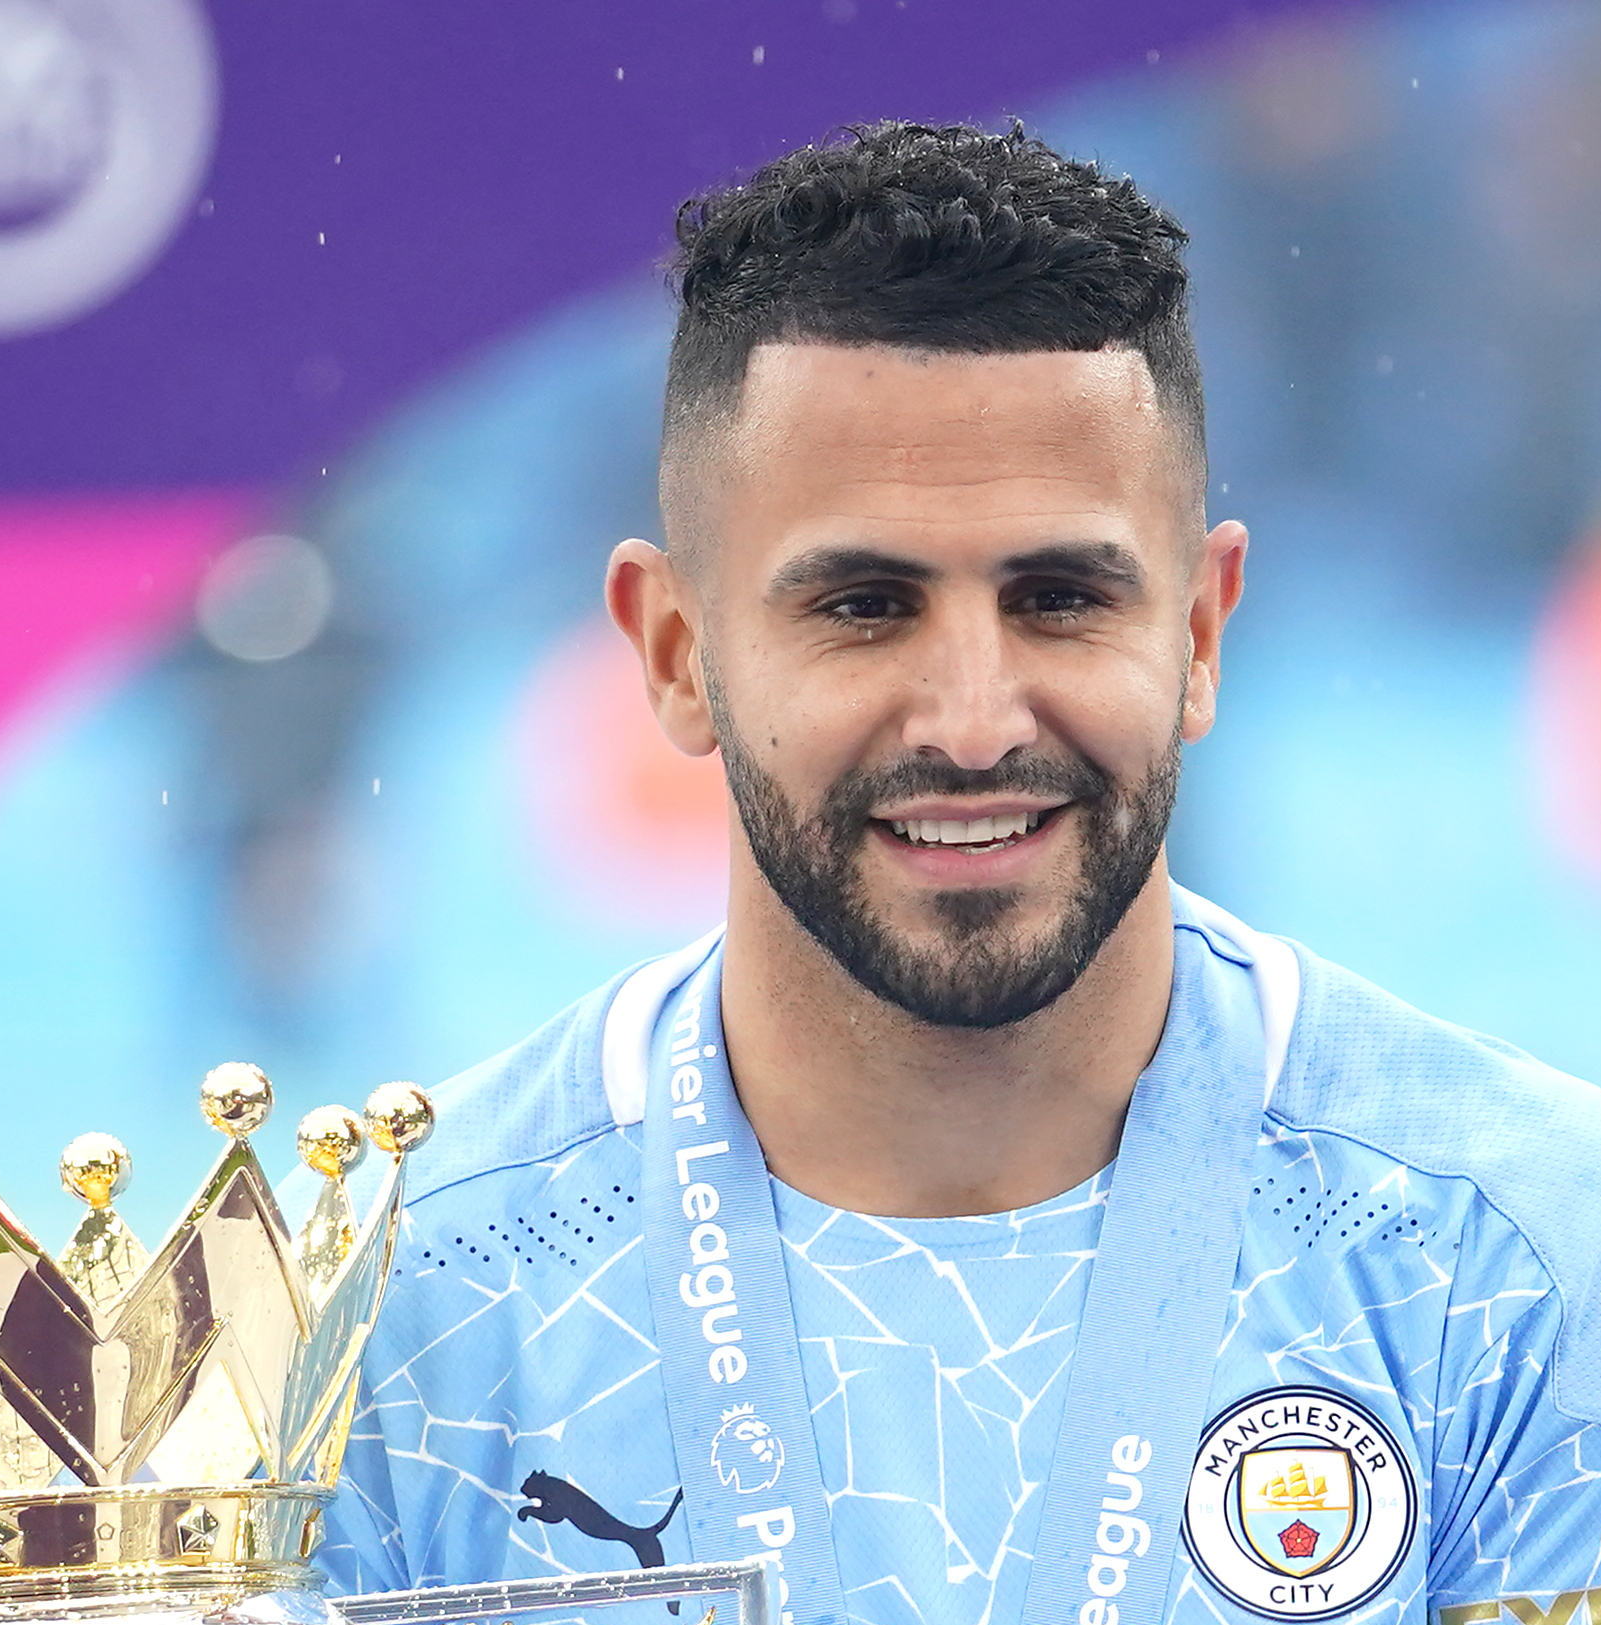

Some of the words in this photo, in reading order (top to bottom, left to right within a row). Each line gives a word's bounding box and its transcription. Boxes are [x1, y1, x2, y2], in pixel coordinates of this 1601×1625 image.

[671, 984, 717, 1126] mier
[674, 1139, 748, 1386] League
[1204, 1405, 1388, 1478] MANCHESTER
[1269, 1583, 1335, 1604] CITY
